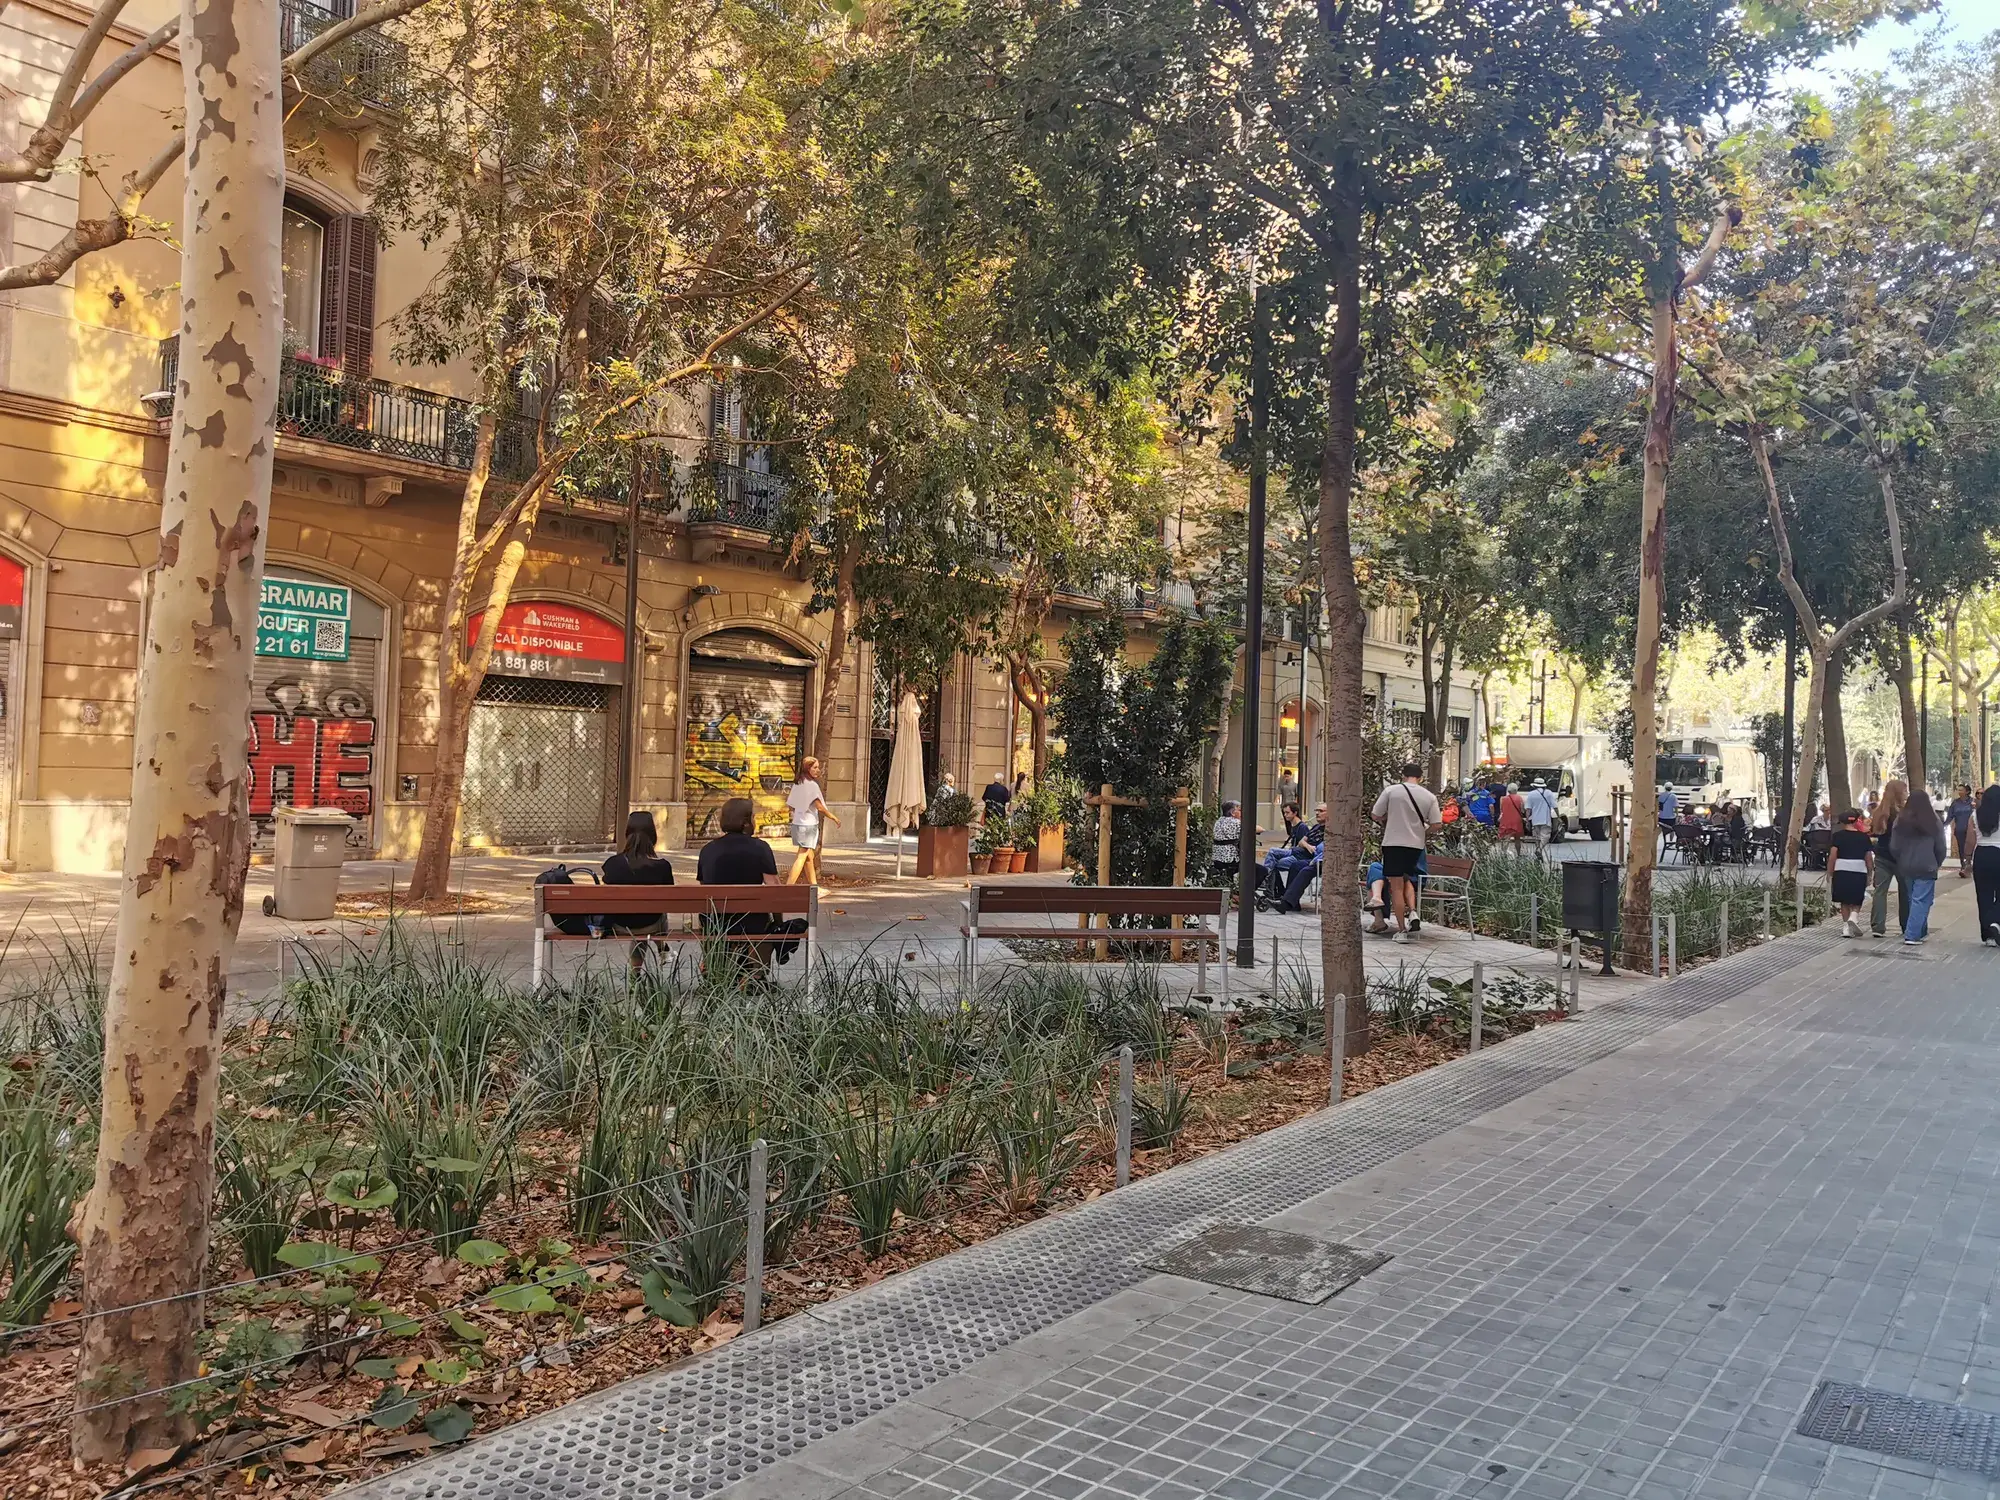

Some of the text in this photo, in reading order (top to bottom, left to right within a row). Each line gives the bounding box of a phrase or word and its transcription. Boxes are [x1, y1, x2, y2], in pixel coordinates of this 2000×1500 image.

[257, 615, 309, 633] GUER
[542, 614, 574, 624] CUSHMAN
[542, 621, 580, 631] WAKEFIELD
[264, 636, 284, 653] 21
[290, 639, 309, 655] 61
[495, 632, 583, 652] CAL DISPONIBLE
[505, 656, 527, 670] 881
[530, 658, 550, 672] 881
